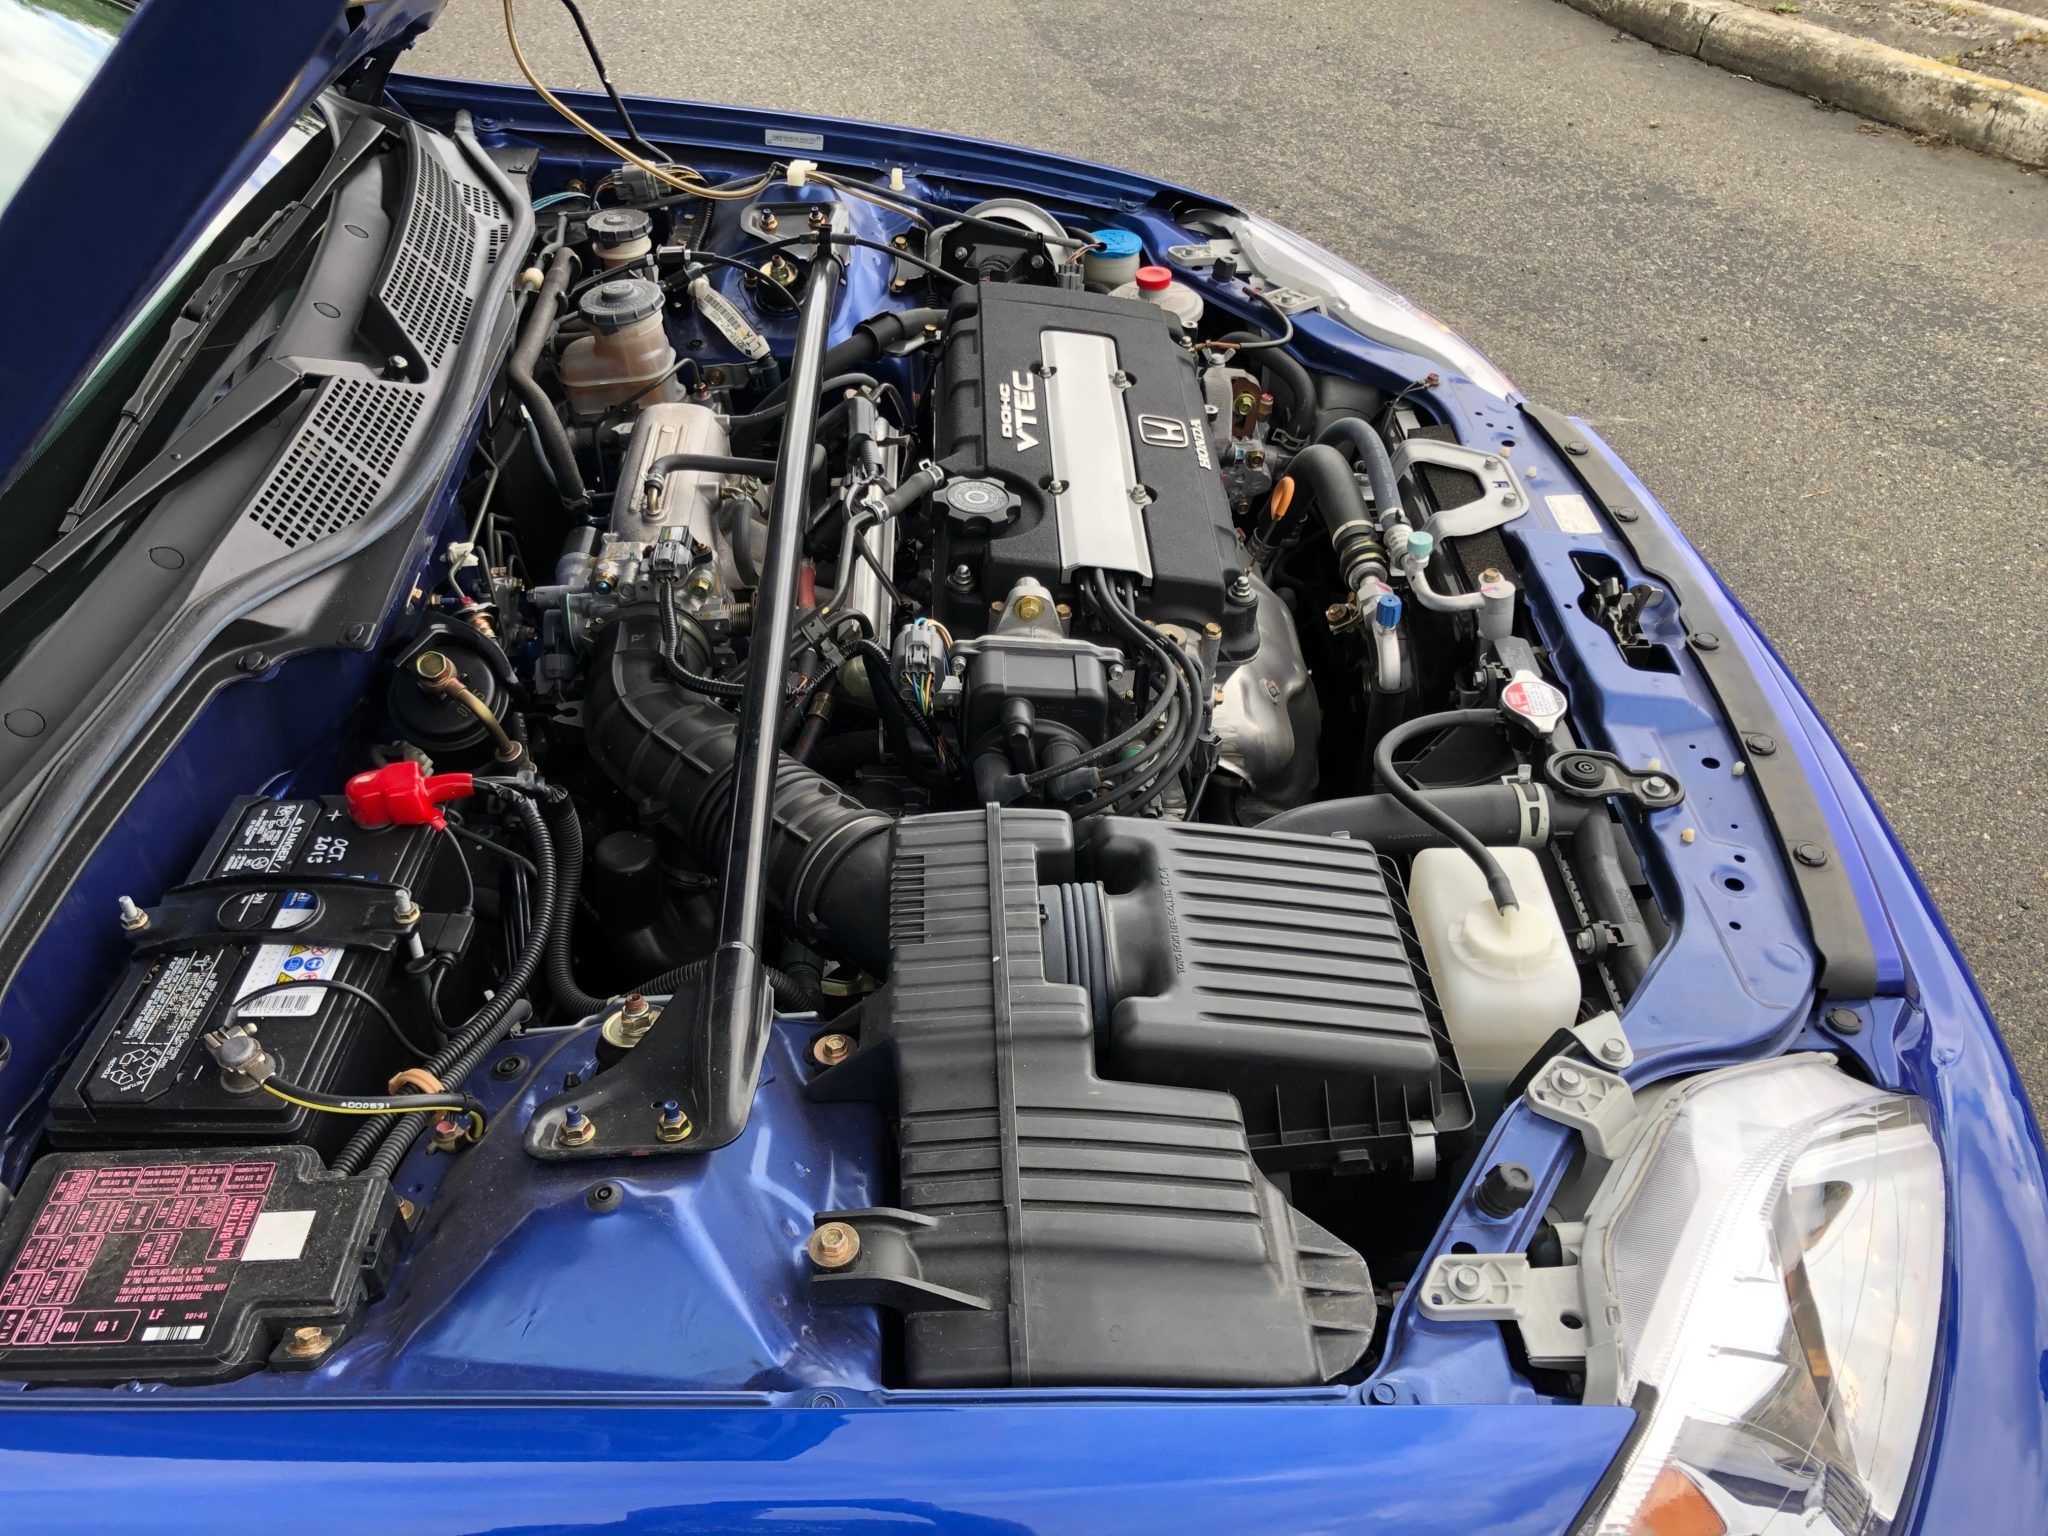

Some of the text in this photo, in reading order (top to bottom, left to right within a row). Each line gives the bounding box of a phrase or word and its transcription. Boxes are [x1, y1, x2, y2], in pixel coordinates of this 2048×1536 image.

[1000, 383, 1012, 437] DOHC
[1012, 370, 1039, 451] VTEC
[1190, 419, 1211, 470] HONDA
[276, 827, 302, 862] DANGER
[307, 837, 332, 863] 2013
[326, 838, 349, 863] OCT.
[101, 1057, 117, 1078] RECYCLE
[223, 1199, 246, 1237] BATTERY
[234, 1199, 259, 1235] BATTERIE
[217, 1240, 235, 1257] 80A
[57, 1321, 78, 1333] 40A
[94, 1320, 109, 1332] IG
[149, 1309, 165, 1320] LF
